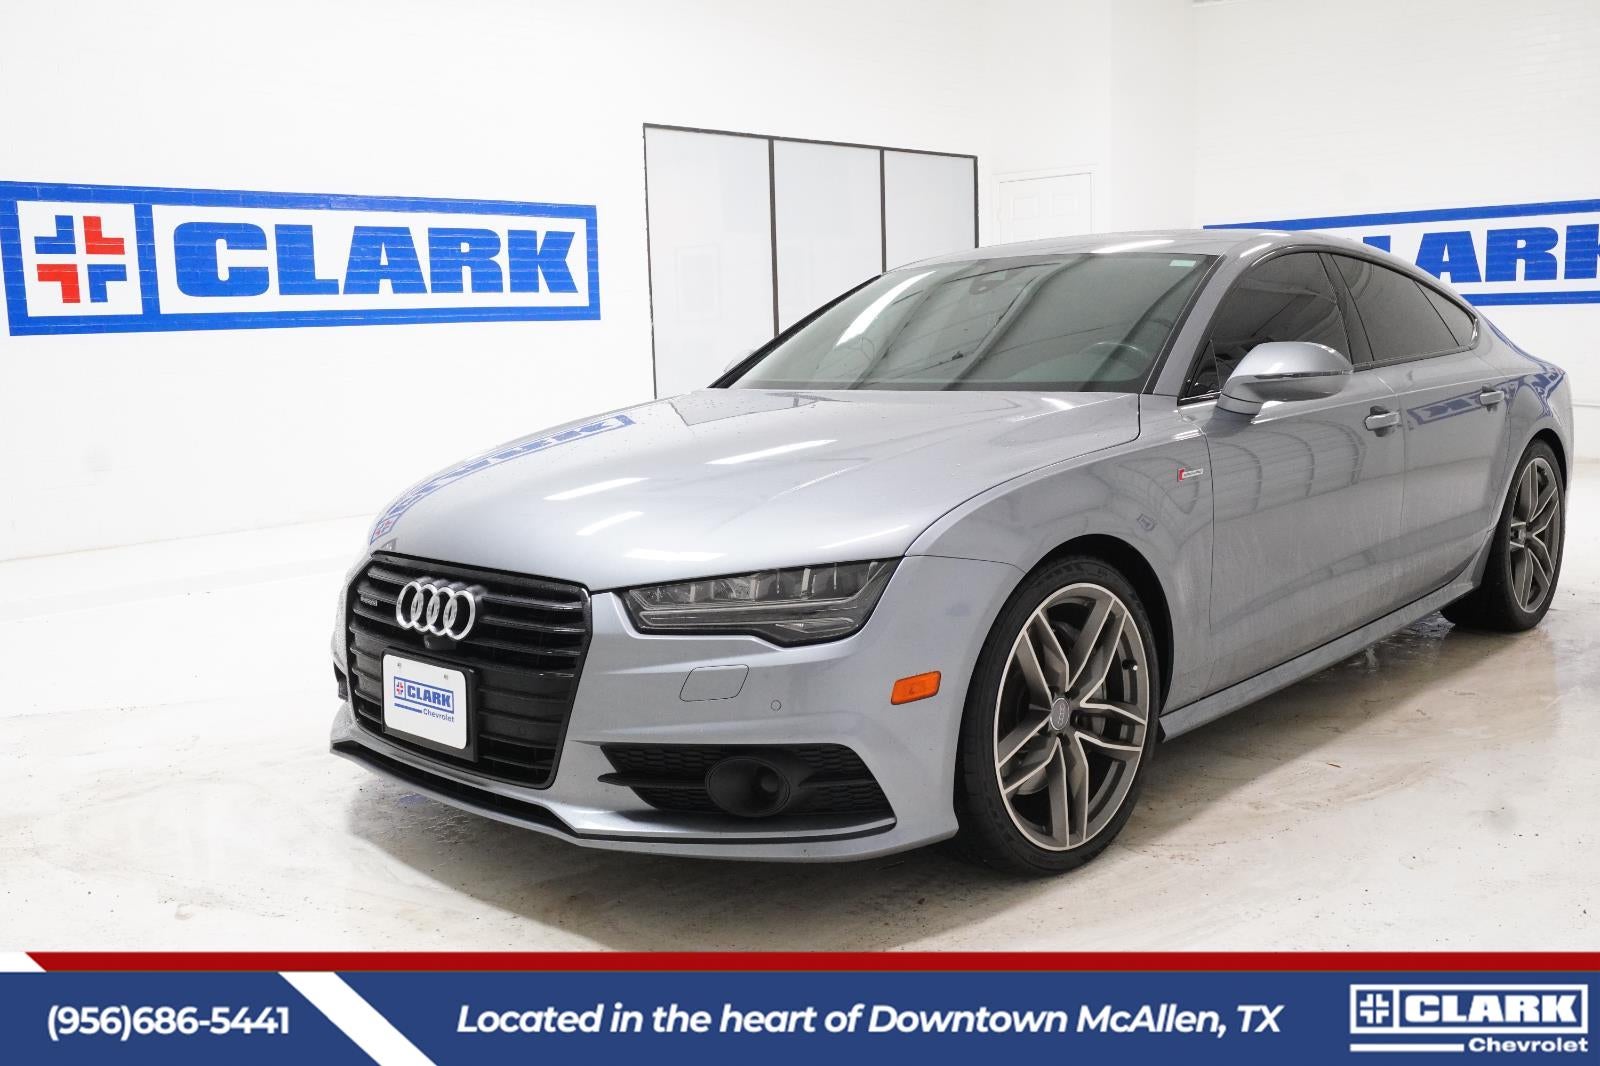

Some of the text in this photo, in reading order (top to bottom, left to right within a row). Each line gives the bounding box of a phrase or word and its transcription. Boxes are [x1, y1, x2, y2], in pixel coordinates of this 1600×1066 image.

[173, 221, 579, 298] CLARK
[407, 685, 451, 707] CLARK
[423, 708, 455, 722] Chevrolet
